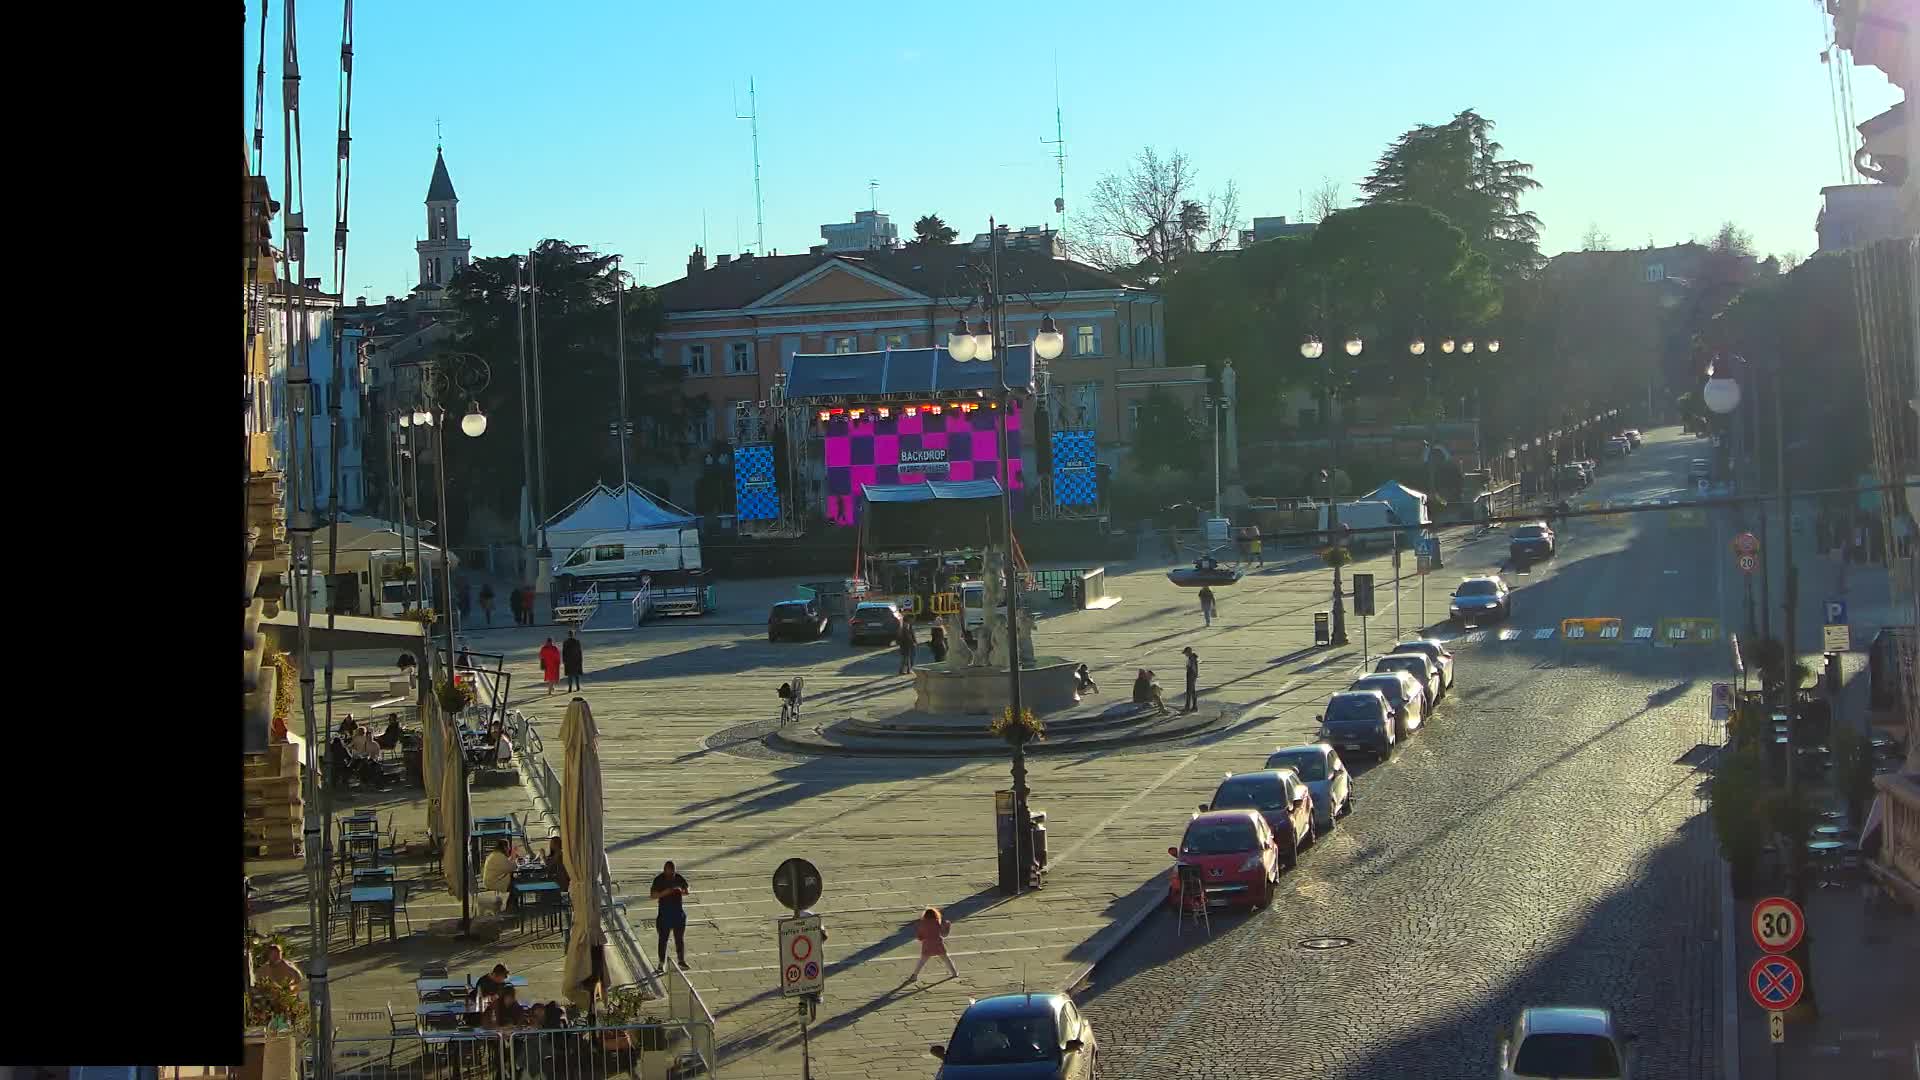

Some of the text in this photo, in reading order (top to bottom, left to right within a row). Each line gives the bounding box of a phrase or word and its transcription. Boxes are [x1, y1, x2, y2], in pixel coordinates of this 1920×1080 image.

[901, 450, 946, 462] BACKDROP
[1742, 558, 1753, 568] 20
[1827, 603, 1842, 623] P
[1762, 912, 1792, 939] 30
[789, 969, 798, 979] 20
